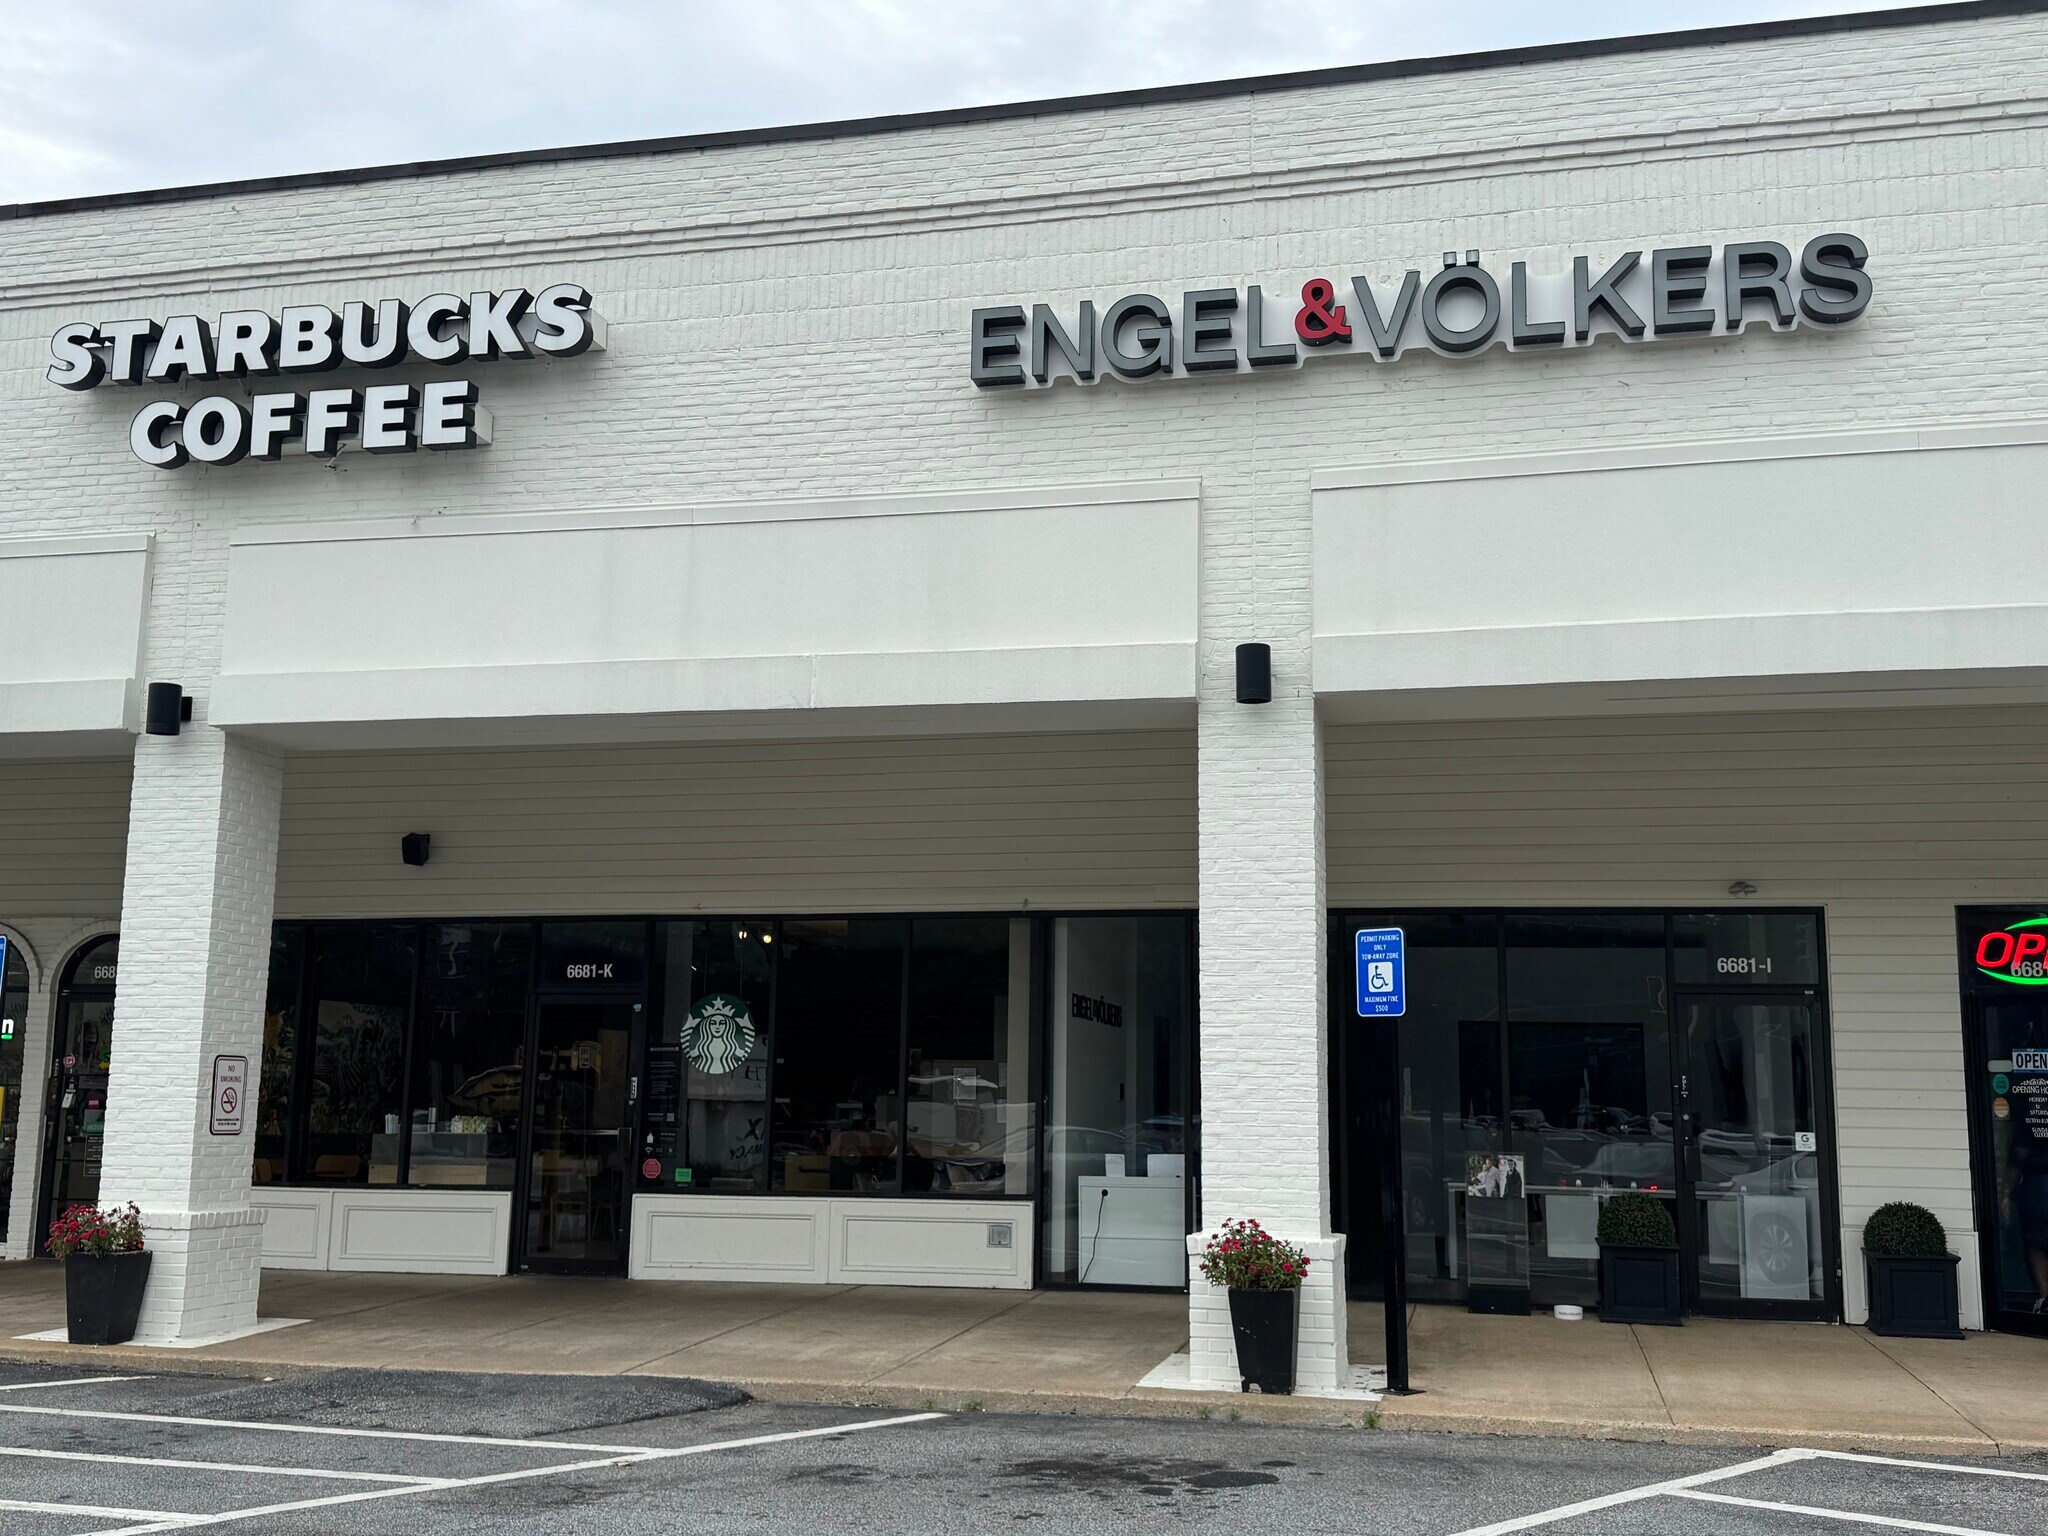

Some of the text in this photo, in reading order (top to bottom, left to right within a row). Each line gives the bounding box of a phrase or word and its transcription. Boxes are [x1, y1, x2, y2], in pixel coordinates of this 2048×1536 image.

[46, 283, 592, 391] STARBUCKS
[130, 380, 478, 469] COFFEE
[1378, 934, 1399, 942] PARKING
[1976, 932, 2048, 970] OP
[566, 963, 613, 978] 6681-K
[2010, 961, 2048, 977] 668
[1375, 1004, 1388, 1012] $500
[2015, 1053, 2048, 1069] OPEN
[2012, 1085, 2039, 1094] OPENING
